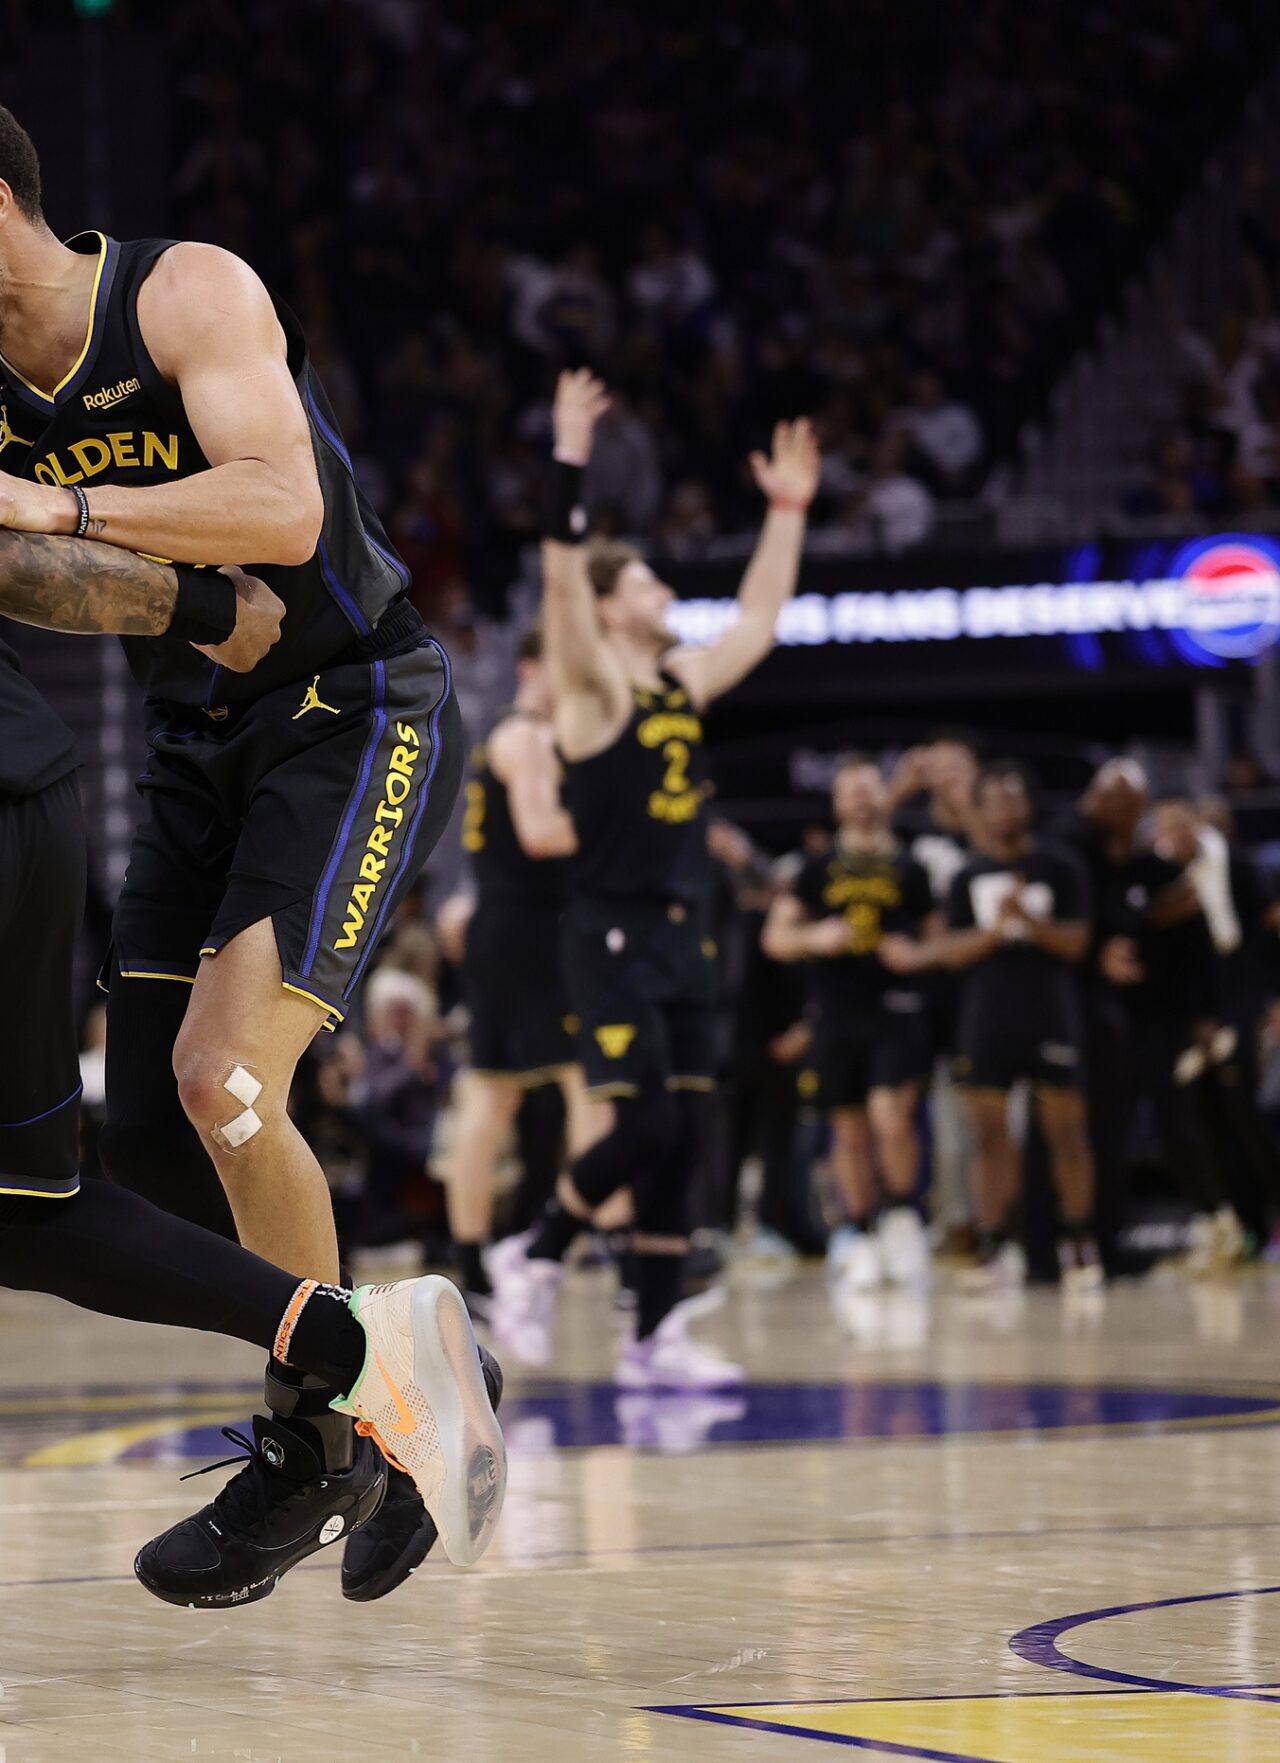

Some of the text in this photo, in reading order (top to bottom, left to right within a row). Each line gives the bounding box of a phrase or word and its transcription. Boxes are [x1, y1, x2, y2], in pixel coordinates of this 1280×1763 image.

[82, 377, 141, 411] Rakuten
[34, 431, 178, 489] OLDEN
[662, 739, 690, 793] 2
[333, 721, 420, 951] WARRIORS
